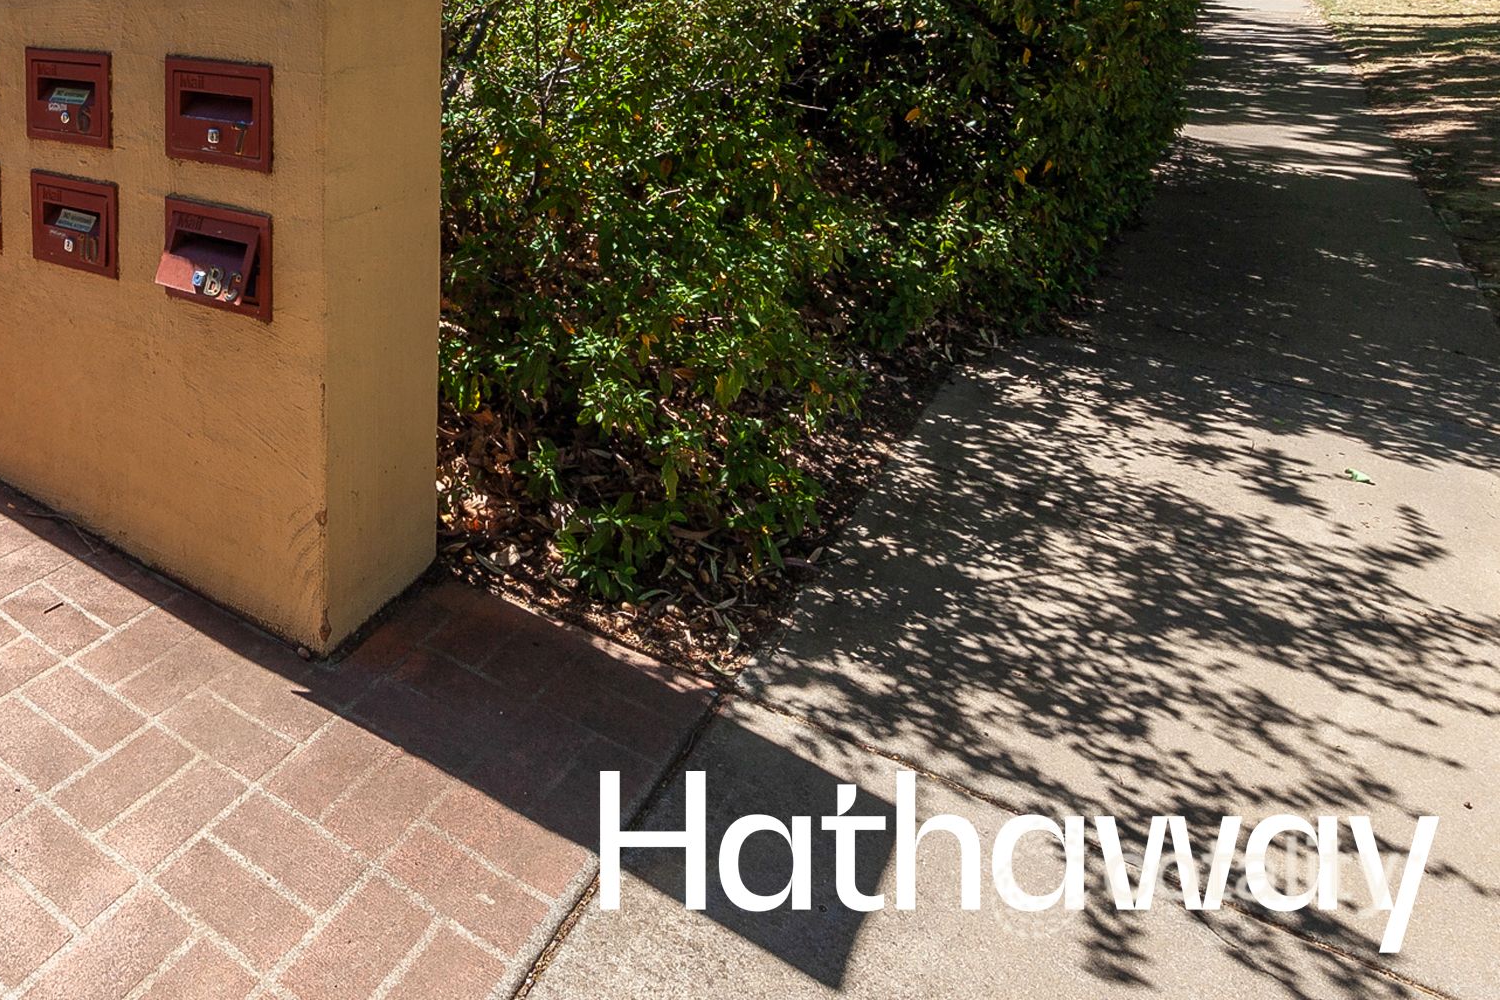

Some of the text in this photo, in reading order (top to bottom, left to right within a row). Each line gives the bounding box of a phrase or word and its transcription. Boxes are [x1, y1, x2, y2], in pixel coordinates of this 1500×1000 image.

[180, 73, 205, 89] Mail
[76, 107, 91, 134] 6
[231, 121, 247, 155] 7
[176, 214, 204, 230] Mail
[78, 233, 99, 265] 10
